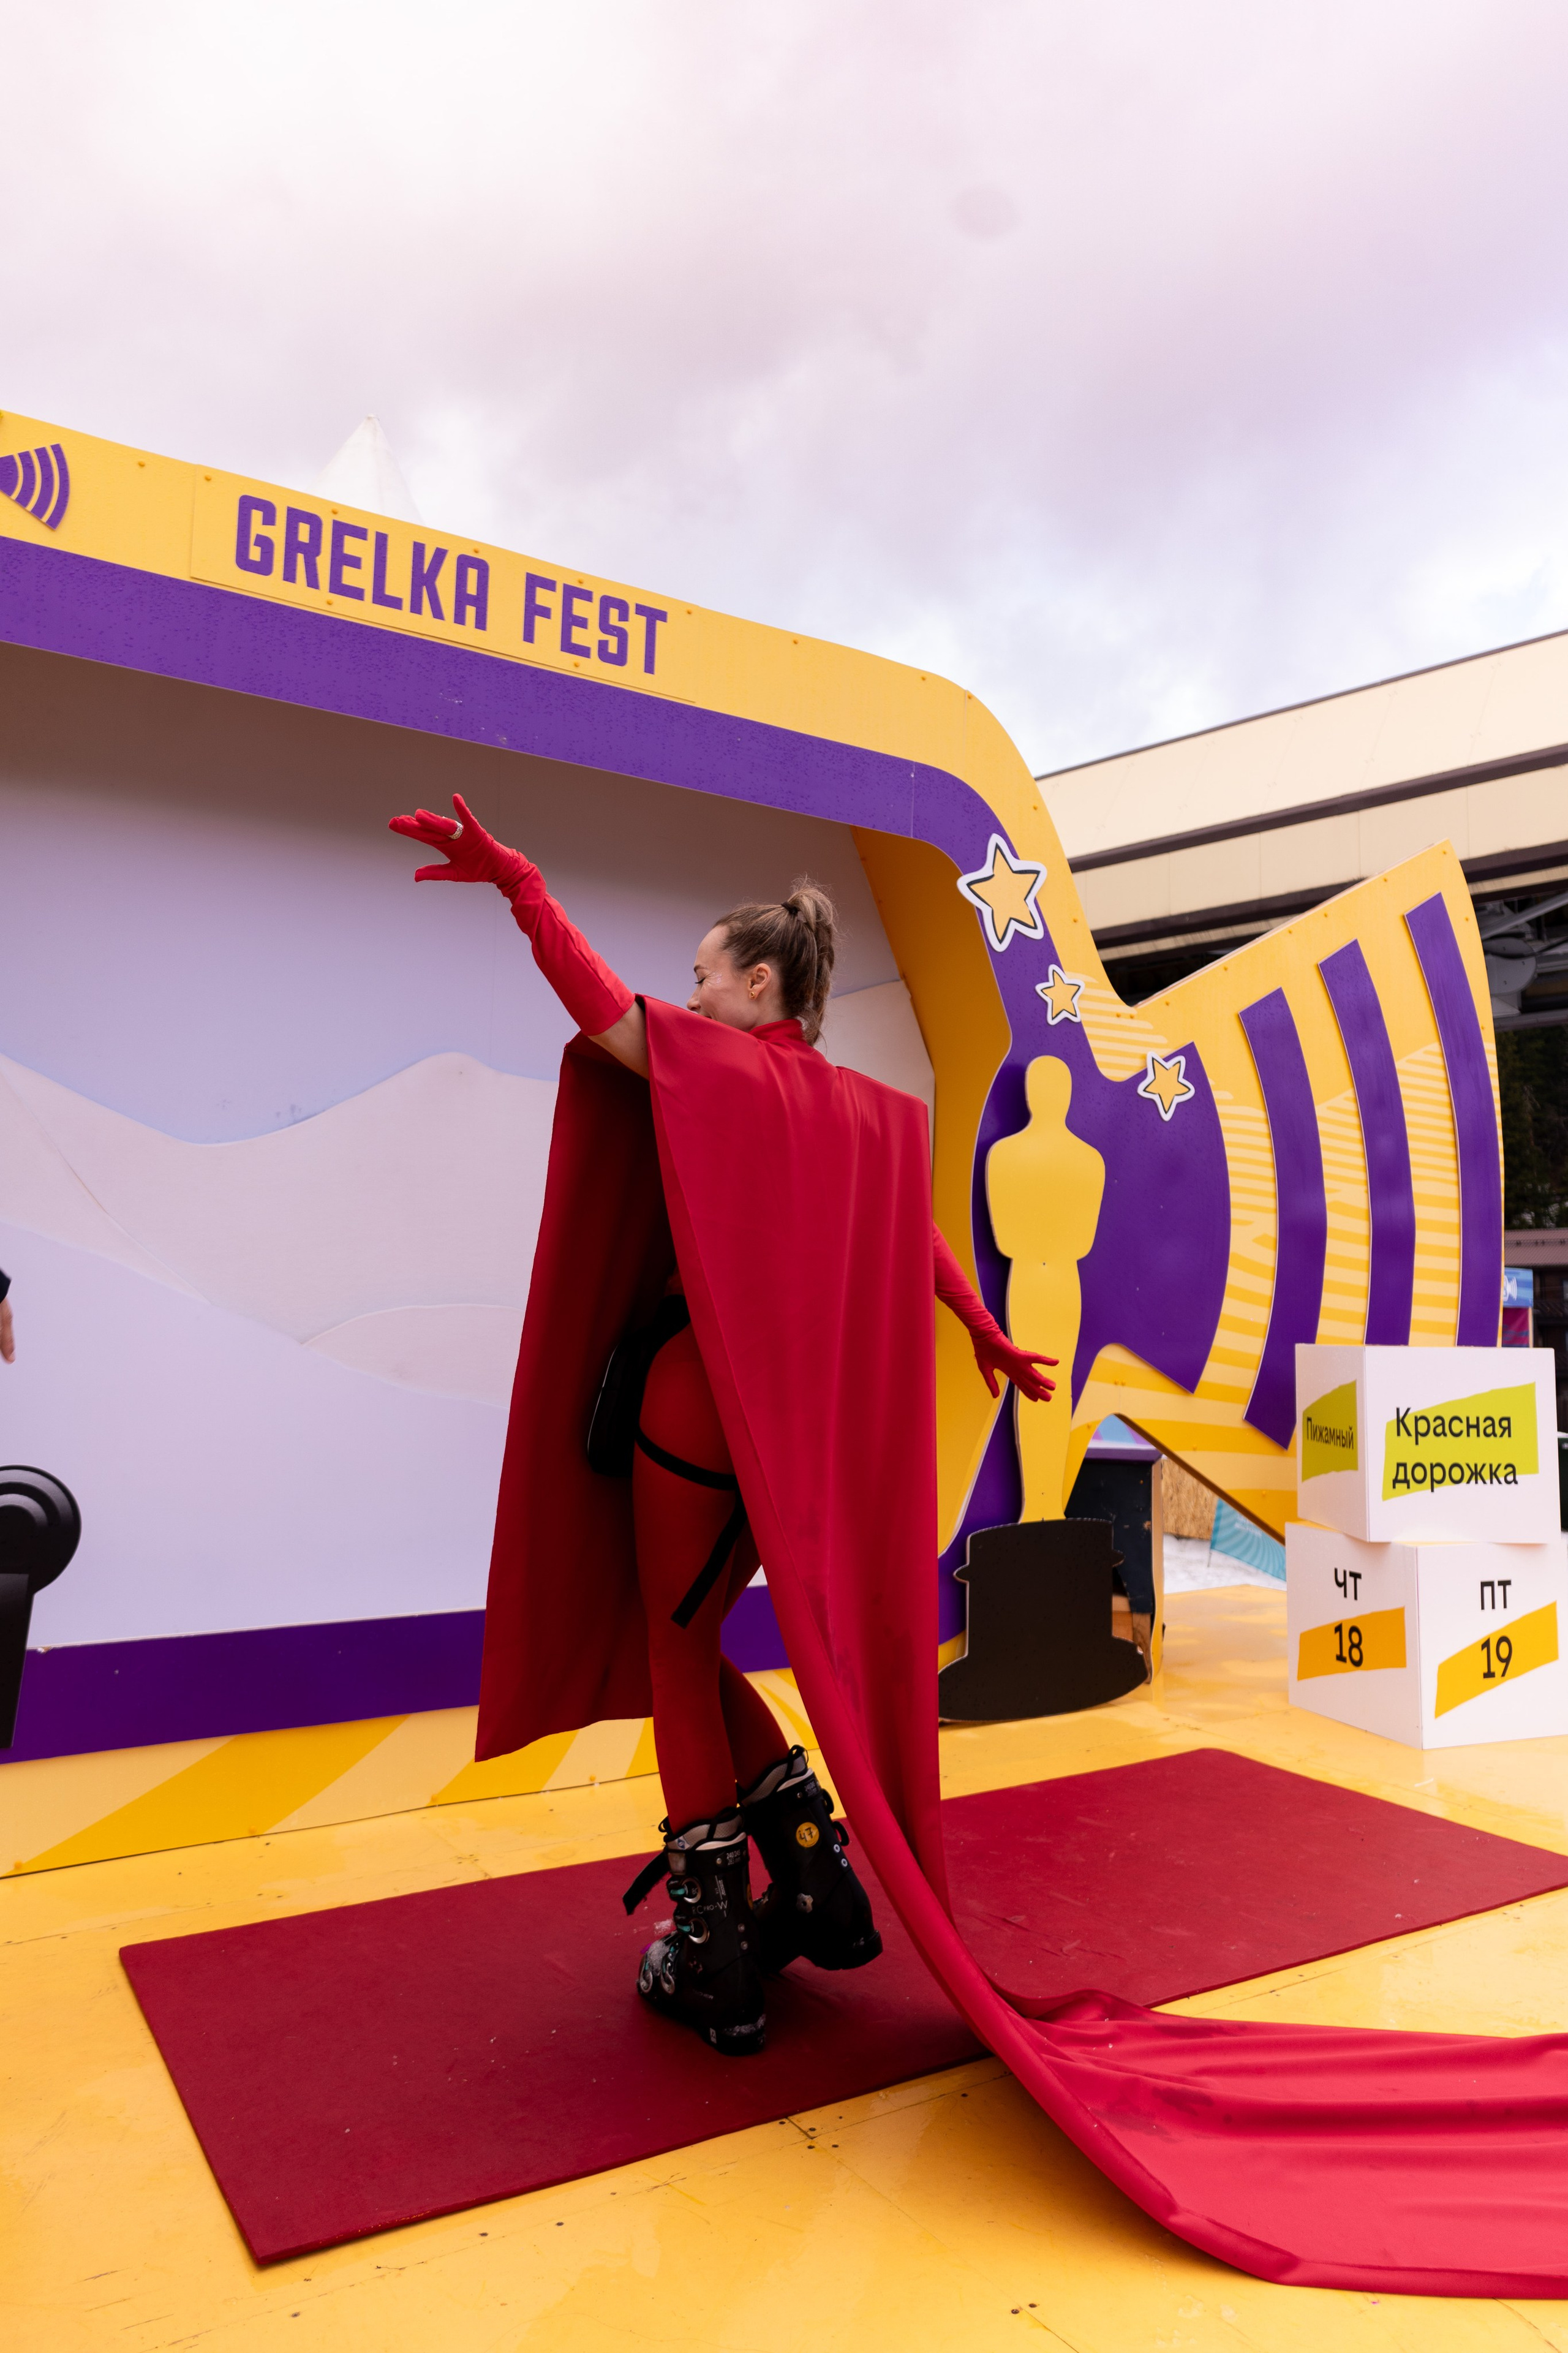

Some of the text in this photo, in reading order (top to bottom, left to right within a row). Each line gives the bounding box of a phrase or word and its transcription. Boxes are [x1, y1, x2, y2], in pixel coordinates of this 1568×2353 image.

[236, 494, 667, 674] GRELKA FEST
[1306, 1416, 1354, 1450] Пижамный
[1396, 1407, 1512, 1446] Красная
[1392, 1462, 1518, 1492] дорожка
[1334, 1622, 1363, 1667] 18
[1481, 1636, 1512, 1679] 19
